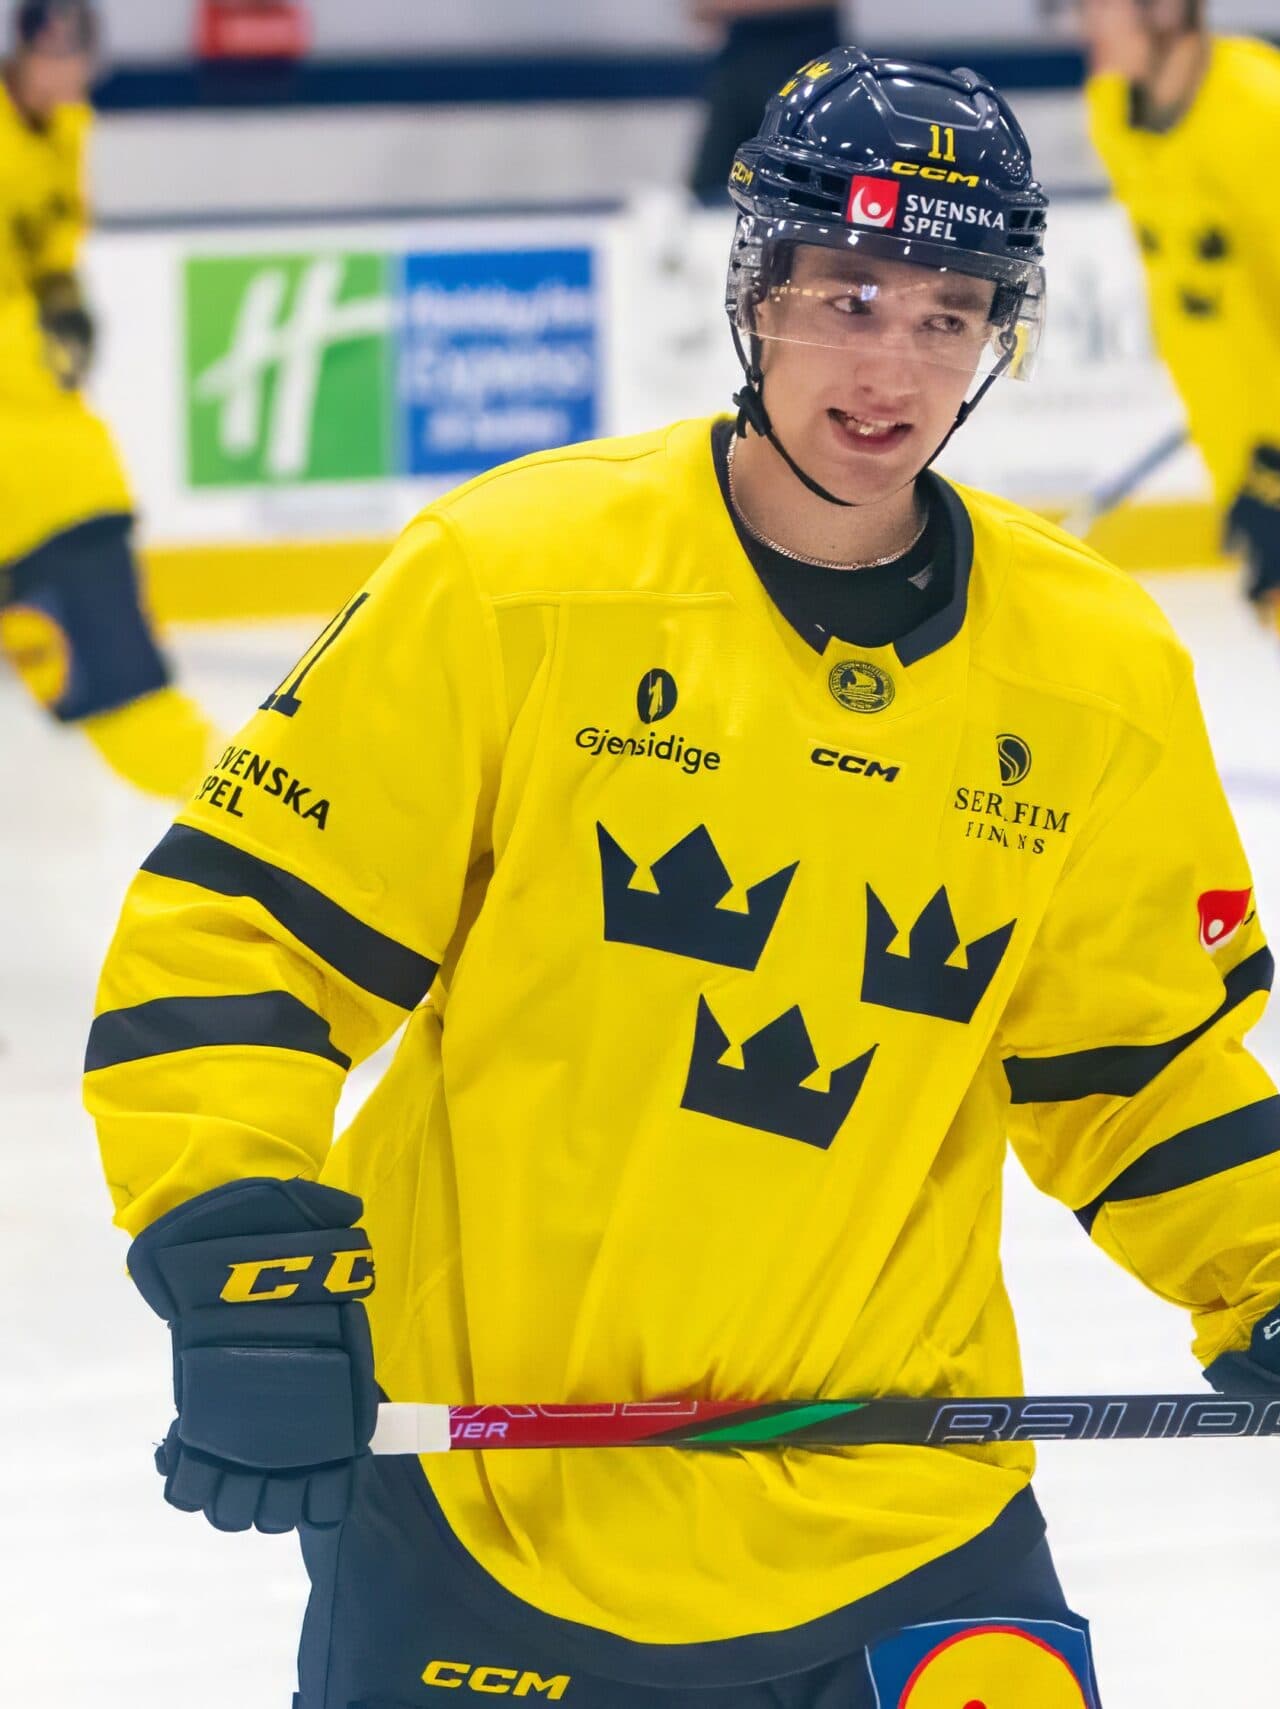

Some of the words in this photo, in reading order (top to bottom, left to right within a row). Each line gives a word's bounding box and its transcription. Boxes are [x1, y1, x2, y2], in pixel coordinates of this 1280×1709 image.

[928, 125, 956, 162] 11
[891, 160, 979, 187] CCM
[901, 215, 957, 241] SPEL
[905, 195, 1005, 231] SVENSKA
[575, 727, 721, 775] Gjensidige
[811, 747, 900, 783] CCM
[954, 787, 1070, 834] SERFIM
[219, 1248, 376, 1303] CC
[421, 1660, 571, 1701] CCM
